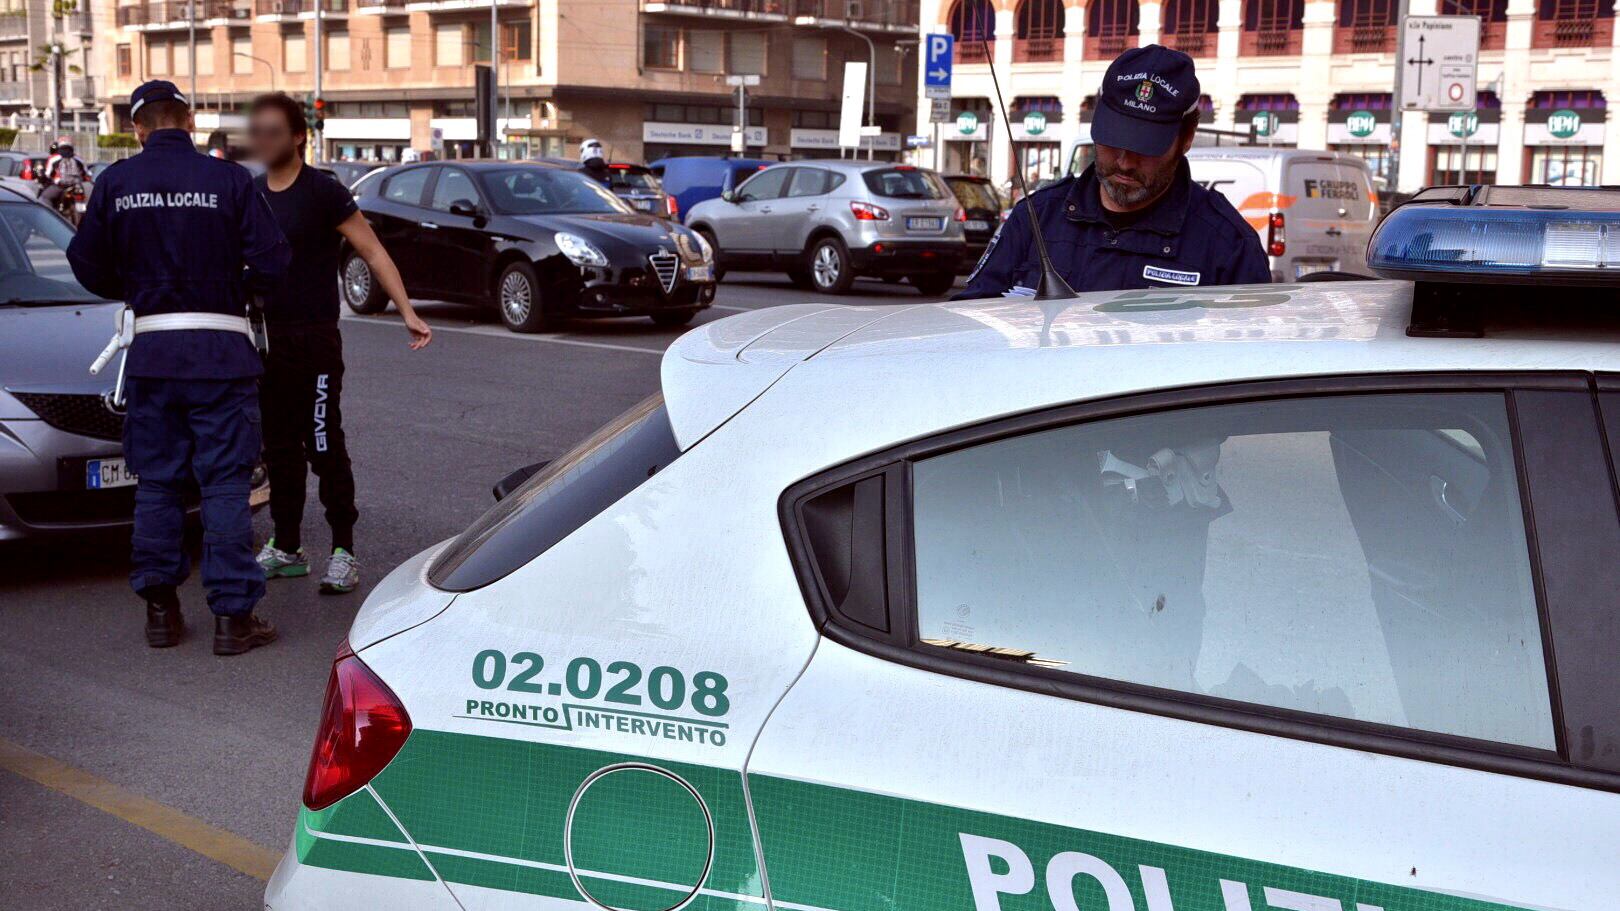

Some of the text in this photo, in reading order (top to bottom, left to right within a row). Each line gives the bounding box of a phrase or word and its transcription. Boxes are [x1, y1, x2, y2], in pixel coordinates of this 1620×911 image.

[931, 37, 947, 63] P
[1117, 72, 1180, 97] POLIZIA LOCALE
[1124, 99, 1157, 113] MILANO
[1347, 116, 1375, 132] BPM
[1548, 115, 1580, 132] BPM
[1320, 180, 1358, 192] GRUPPO
[115, 192, 218, 212] POLIZIA LOCALE
[1146, 269, 1171, 279] POLIZIA
[314, 374, 328, 451] GIVOVA
[472, 649, 730, 717] 02.0208
[466, 699, 726, 747] PRONTO INTERVENTO
